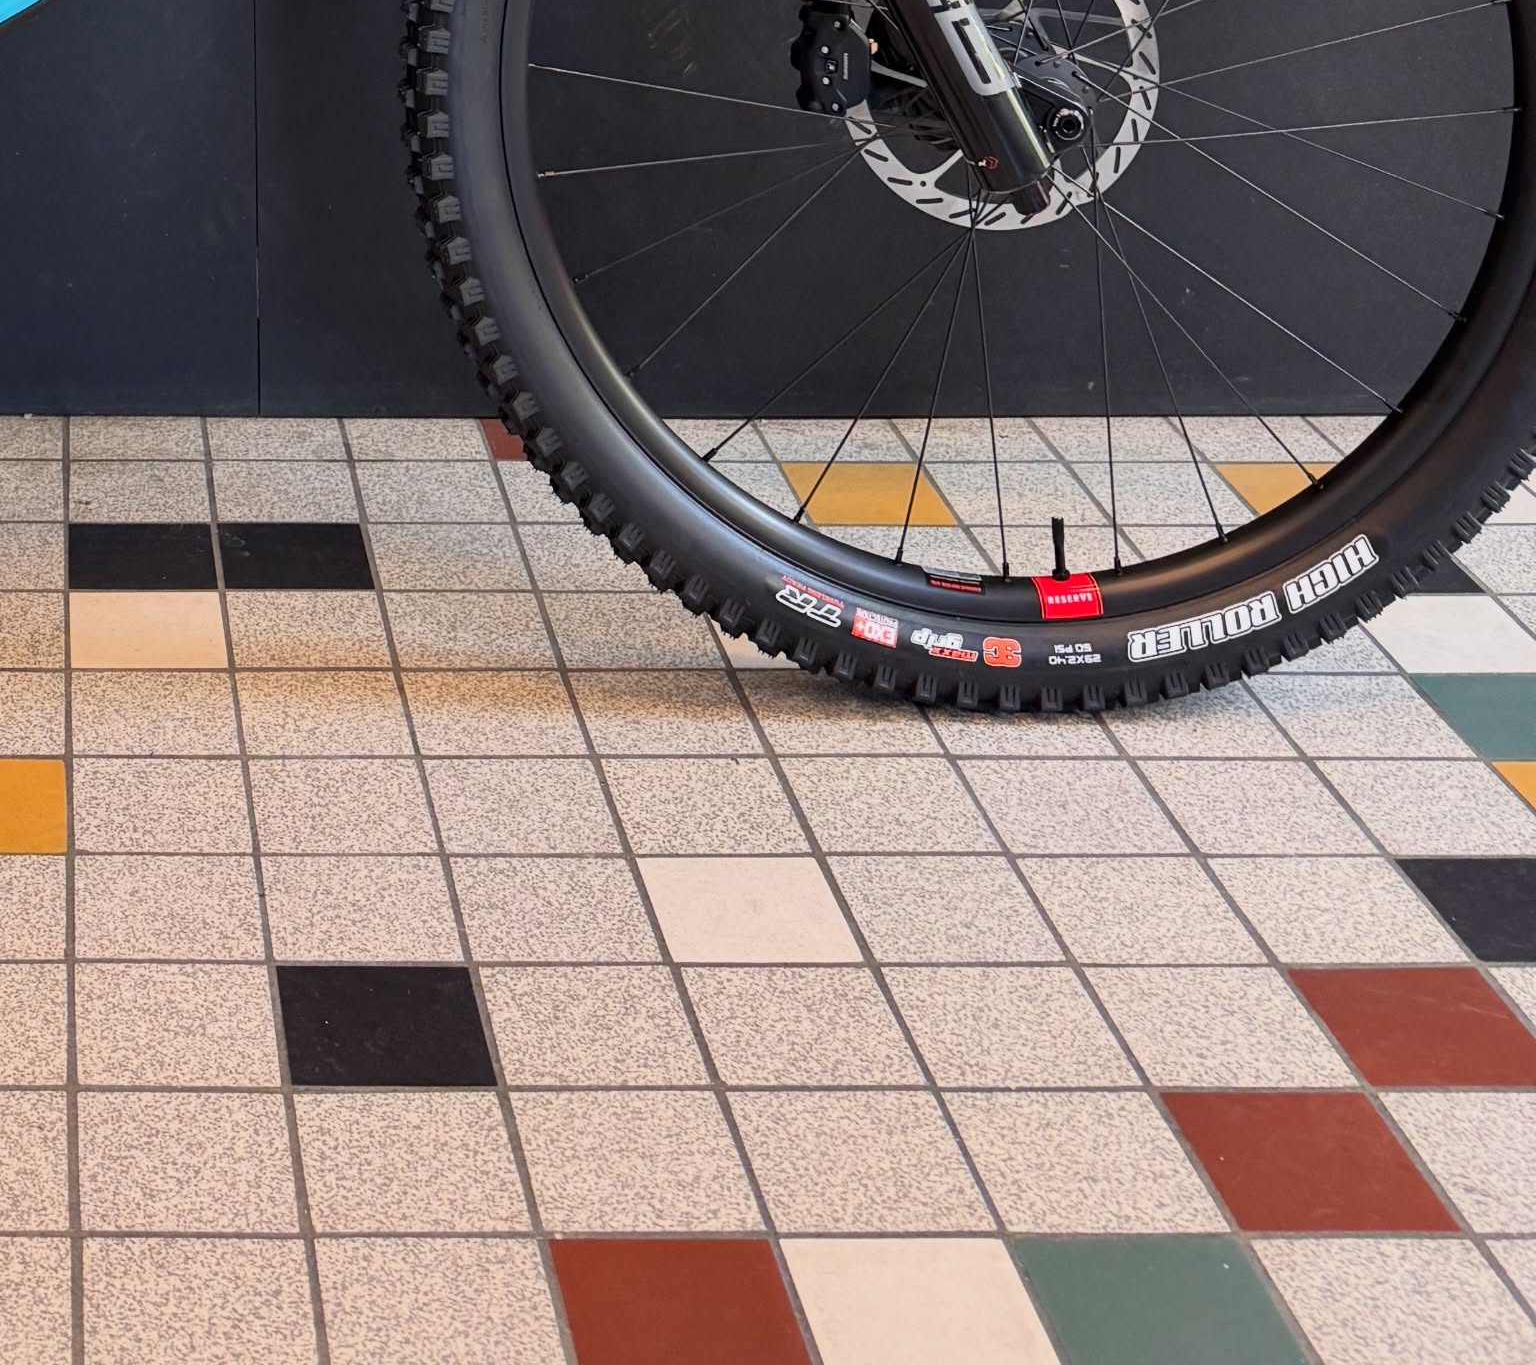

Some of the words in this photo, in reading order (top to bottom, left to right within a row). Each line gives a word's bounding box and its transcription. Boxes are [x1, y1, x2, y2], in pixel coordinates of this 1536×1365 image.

[1283, 534, 1380, 614] HIGH
[776, 583, 842, 628] TR
[1047, 592, 1093, 605] RESERVE
[852, 619, 897, 645] EXO+
[1128, 591, 1282, 662] ROLLER
[910, 628, 964, 651] grip
[1054, 644, 1073, 653] PSI
[1074, 643, 1092, 652] 50
[928, 645, 979, 663] maxx
[1048, 654, 1102, 666] 29X2.40
